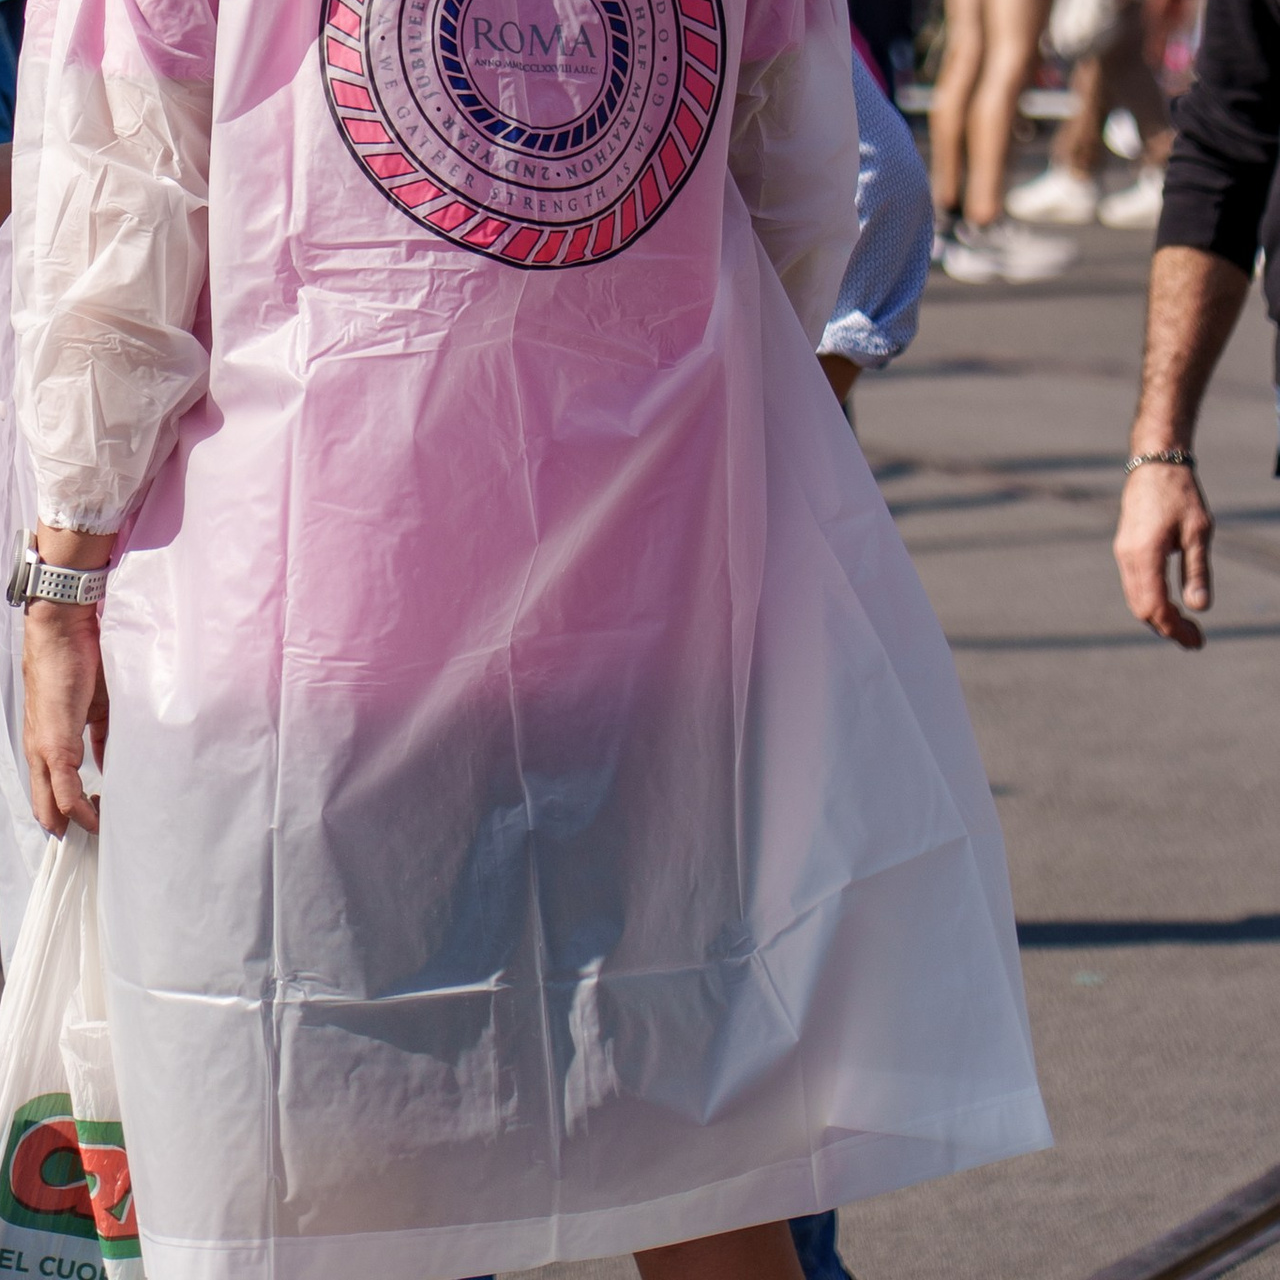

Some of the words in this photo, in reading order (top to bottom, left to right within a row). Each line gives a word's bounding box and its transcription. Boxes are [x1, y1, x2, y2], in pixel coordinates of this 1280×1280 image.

[408, 0, 441, 101] JUBILEE
[472, 17, 596, 58] ROMA
[474, 58, 502, 68] ANNO
[634, 6, 647, 71] HALF
[379, 55, 399, 90] WE
[396, 106, 475, 188] GATHER
[490, 186, 606, 213] STRENGTH
[616, 162, 631, 187] AS
[634, 121, 653, 153] WE
[652, 72, 669, 107] GO
[442, 113, 491, 165] YEAR
[566, 82, 642, 180] MARATHON
[505, 159, 551, 181] 2ND
[38, 1255, 108, 1280] CUO
